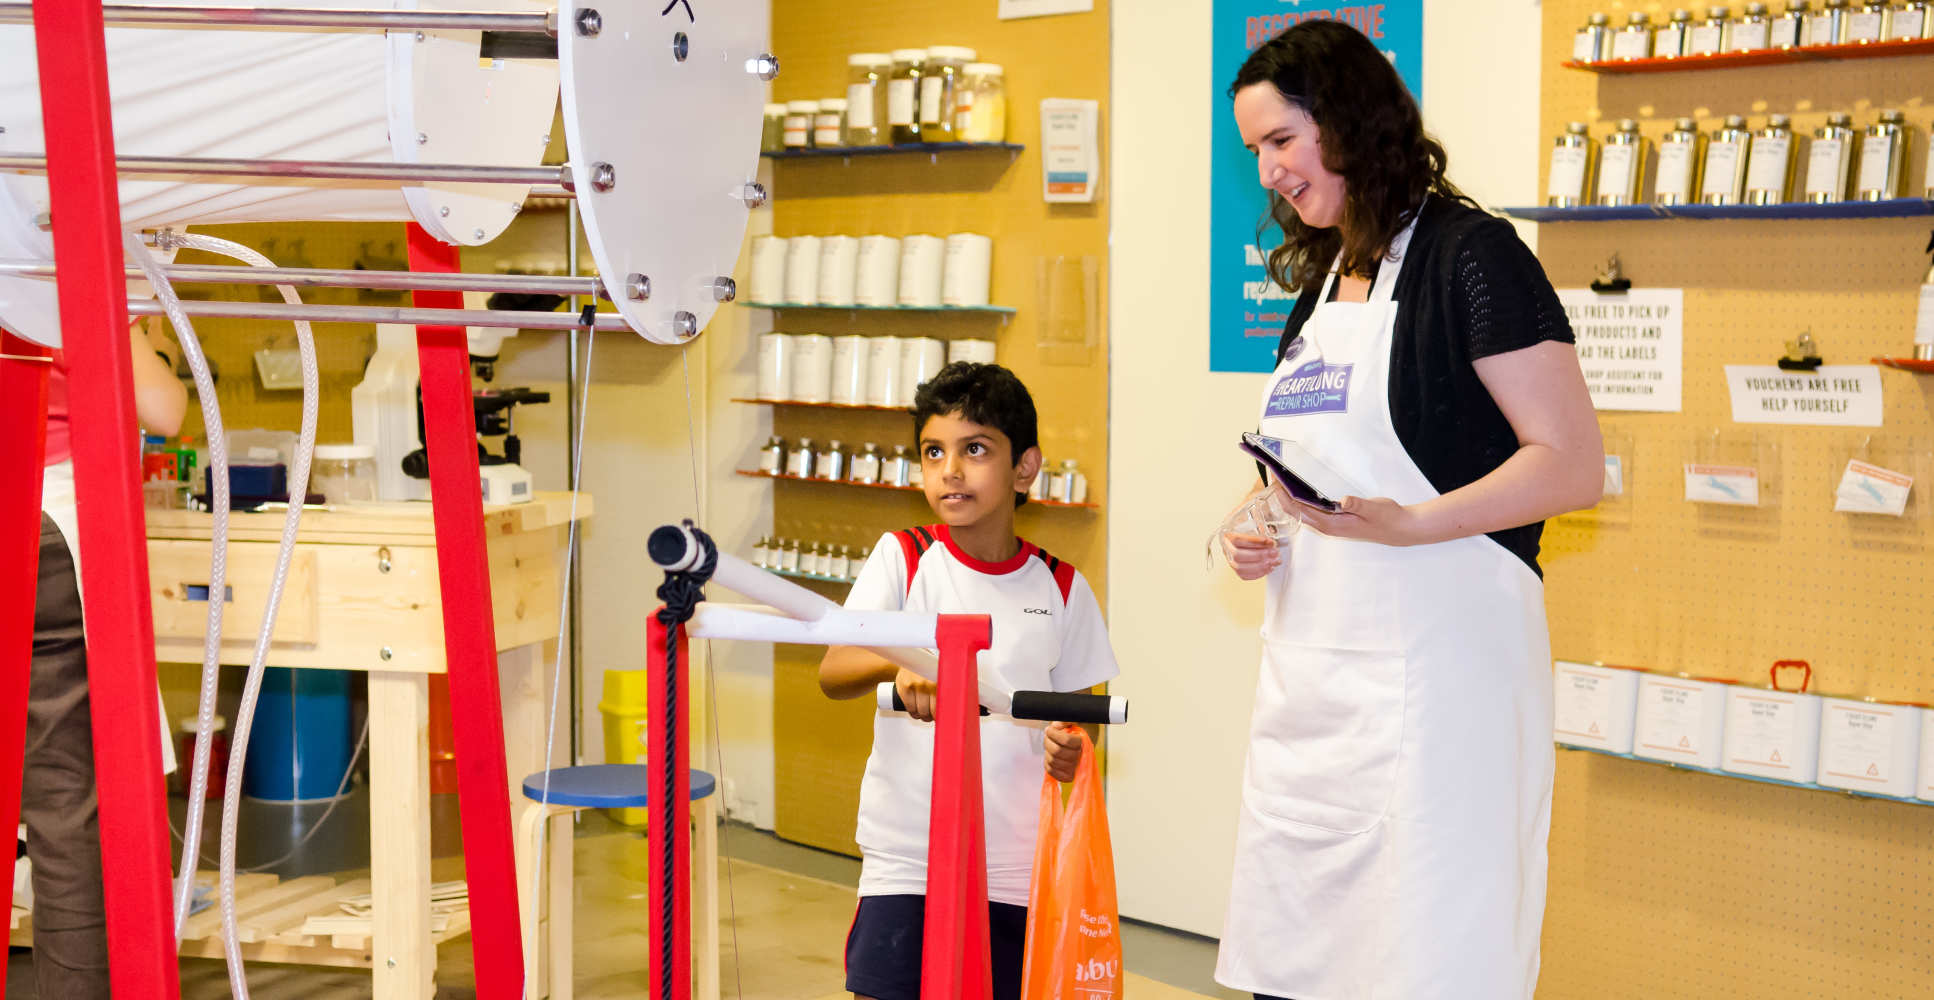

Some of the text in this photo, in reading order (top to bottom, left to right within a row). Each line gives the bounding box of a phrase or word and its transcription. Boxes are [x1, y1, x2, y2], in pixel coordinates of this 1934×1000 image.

[1584, 304, 1608, 320] FREE
[1612, 304, 1625, 320] TO
[1628, 304, 1652, 320] PICK
[1656, 304, 1670, 320] UP
[1586, 325, 1637, 339] PRODUCTS
[1641, 325, 1662, 339] AND
[1597, 345, 1615, 360] THE
[1618, 345, 1657, 360] LABELS
[1603, 384, 1654, 395] INFORMATION
[1745, 377, 1862, 394] VOUCHERS ARE FREE
[1302, 391, 1326, 409] SHOP
[1761, 397, 1849, 413] HELP YOURSELF
[1023, 607, 1053, 616] GOL
